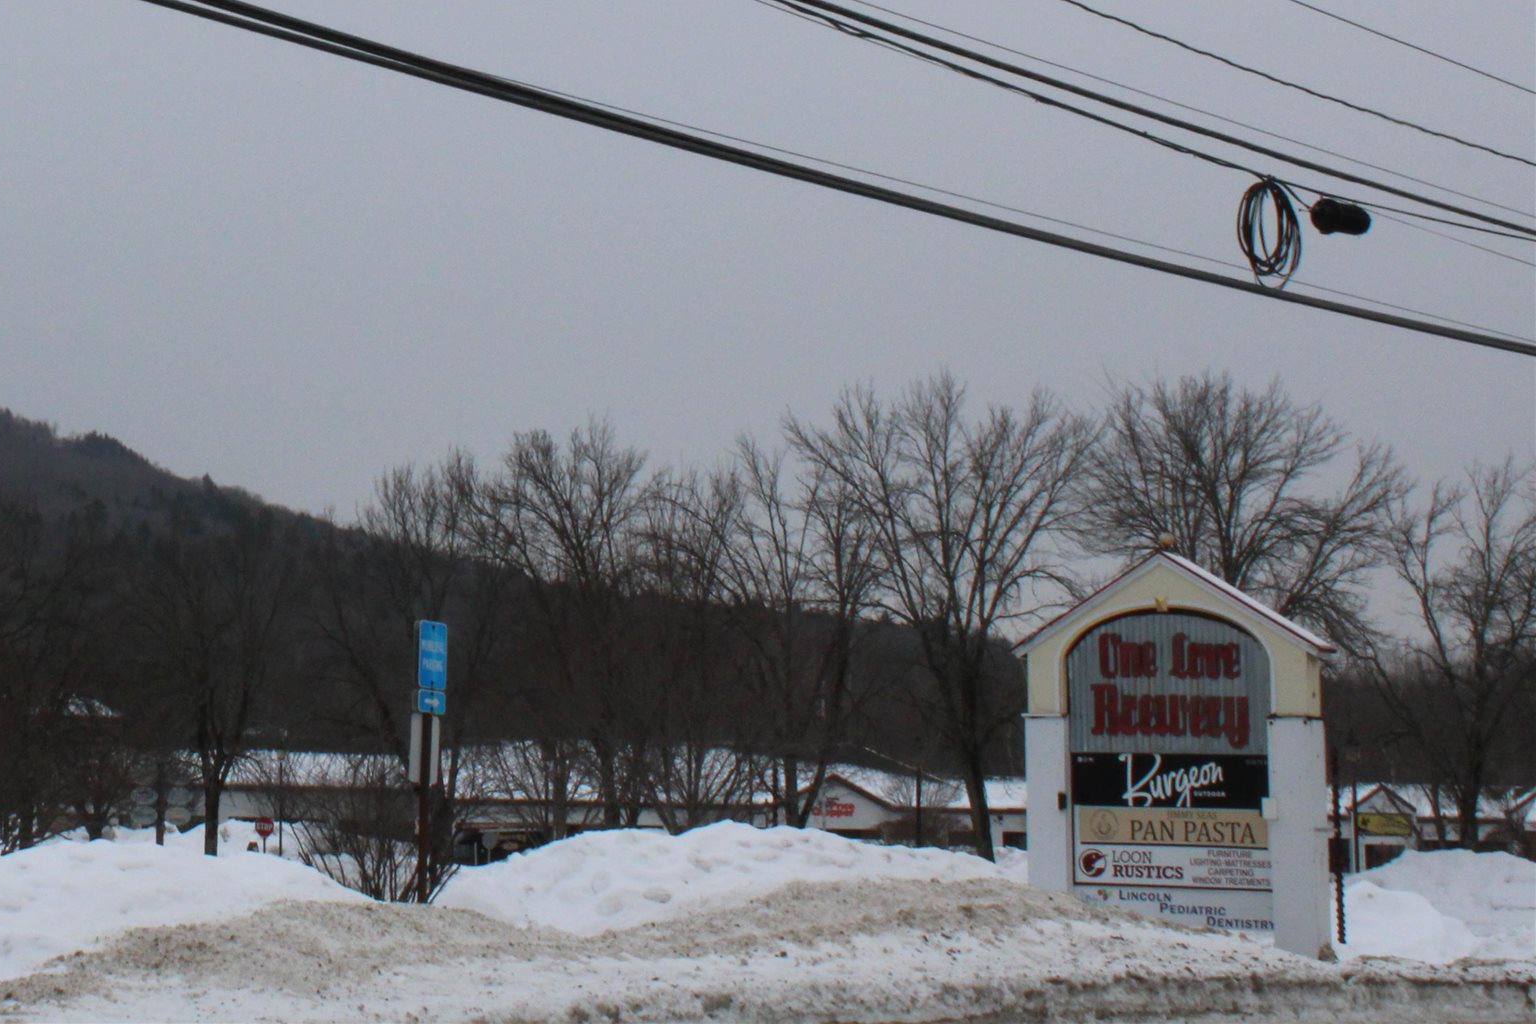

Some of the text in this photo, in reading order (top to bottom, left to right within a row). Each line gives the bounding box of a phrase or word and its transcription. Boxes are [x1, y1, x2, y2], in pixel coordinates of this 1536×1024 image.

[1099, 632, 1241, 678] One Love
[1118, 752, 1224, 807] Burgeon
[1130, 819, 1256, 844] PAN PASTA
[1112, 850, 1153, 865] LOON
[1207, 849, 1253, 858] FURNITURE
[1112, 864, 1184, 880] RUSTICS
[1207, 867, 1254, 877] CARPETING
[1191, 876, 1271, 887] WINDOW TREATMENTS
[1119, 890, 1172, 902] LINCOLN
[1159, 902, 1227, 916] PEDIATRIC
